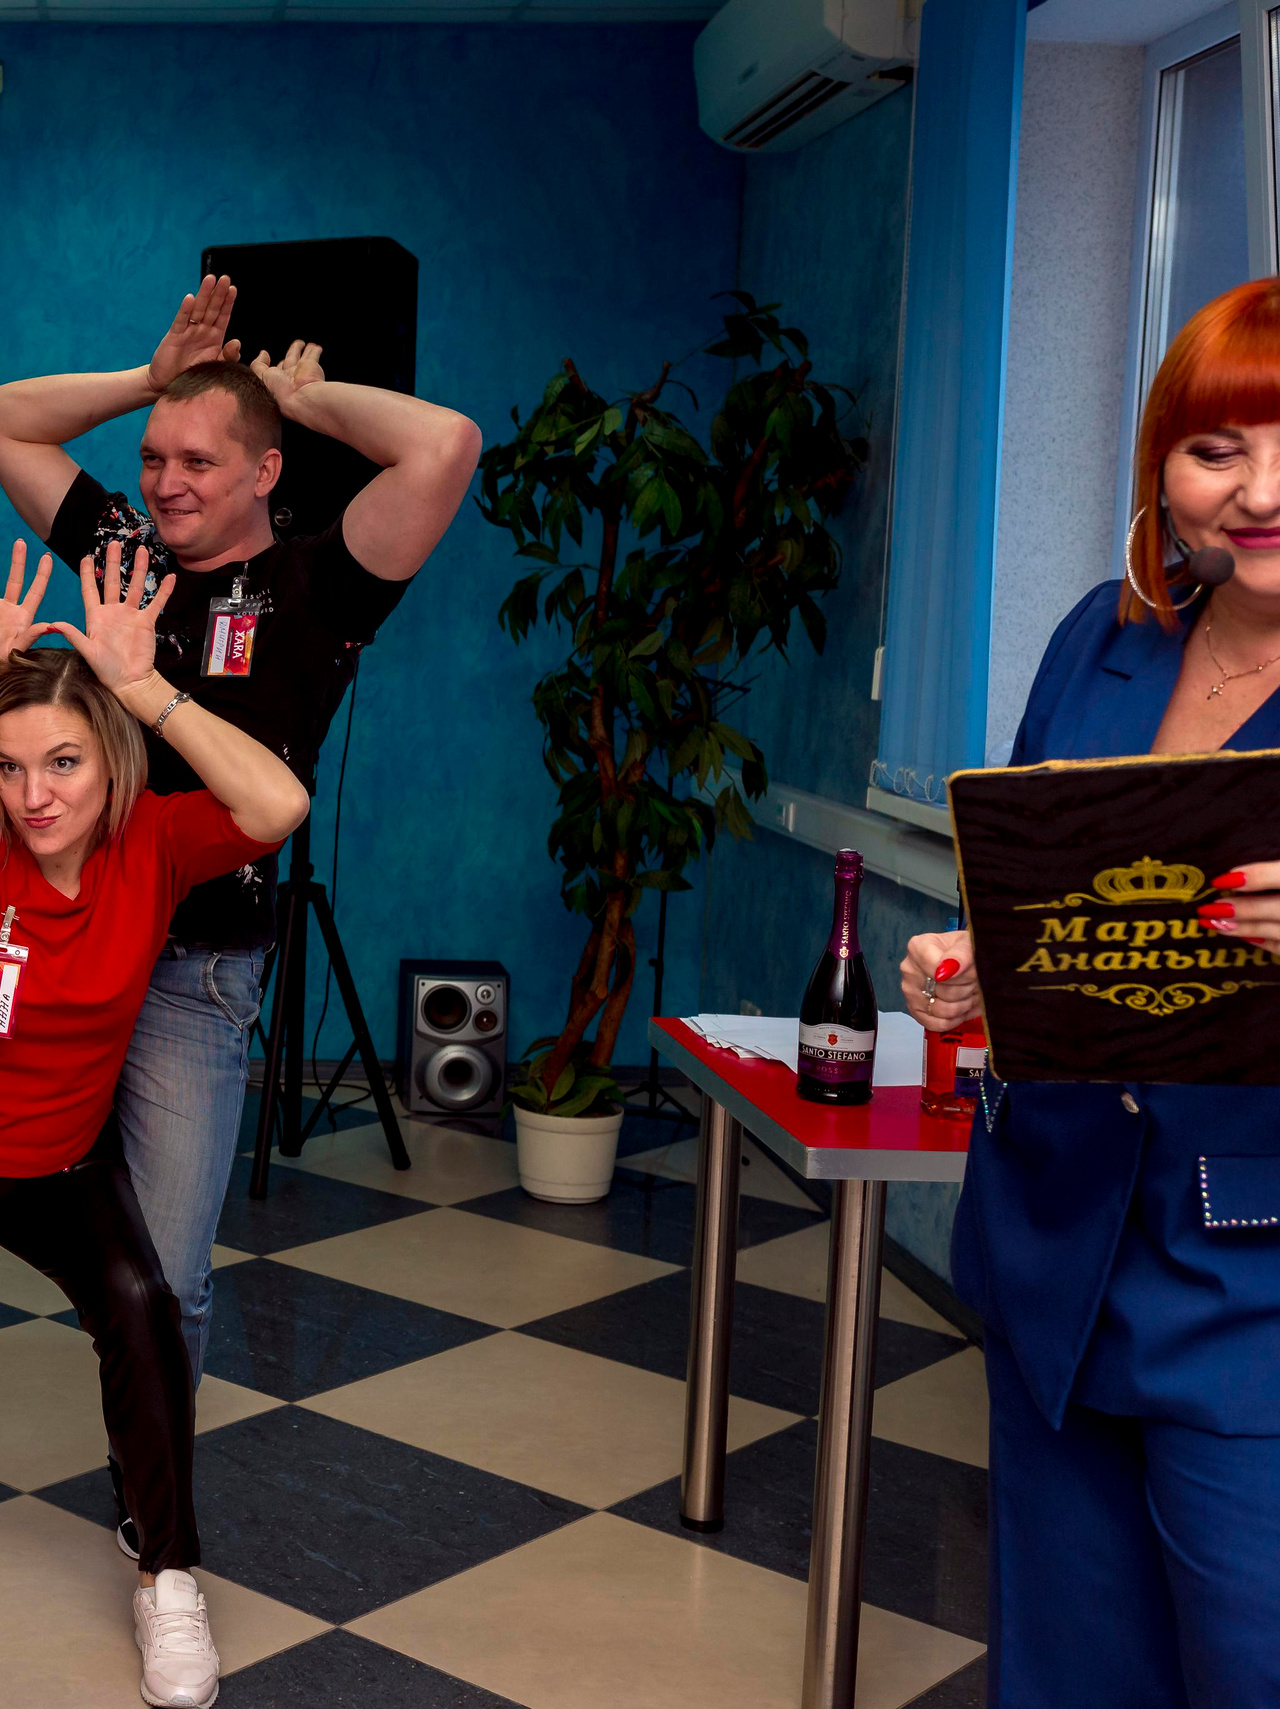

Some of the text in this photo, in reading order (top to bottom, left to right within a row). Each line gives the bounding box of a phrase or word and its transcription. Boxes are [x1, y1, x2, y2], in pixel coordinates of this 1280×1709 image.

[232, 629, 246, 660] XARA
[1035, 916, 1218, 948] Мари
[802, 1045, 825, 1058] SANTO
[827, 1051, 866, 1061] STEFANO
